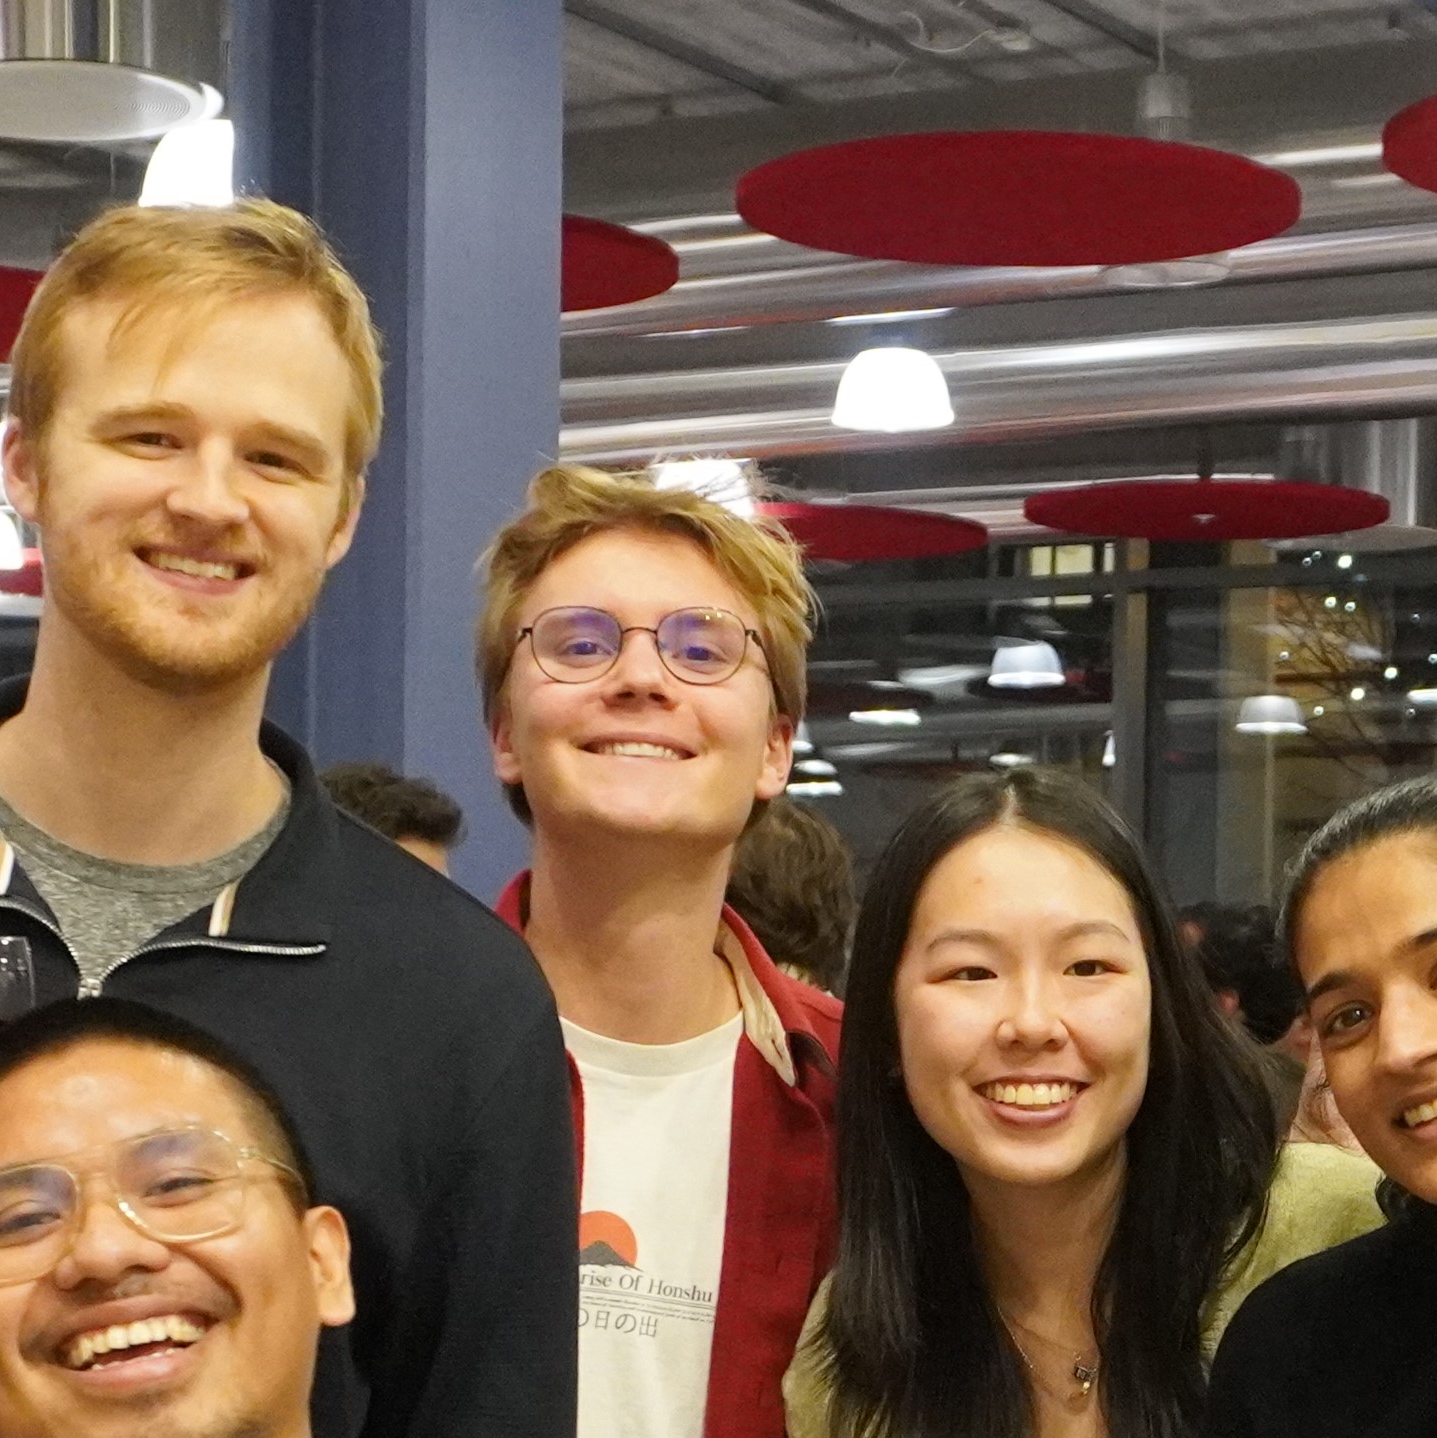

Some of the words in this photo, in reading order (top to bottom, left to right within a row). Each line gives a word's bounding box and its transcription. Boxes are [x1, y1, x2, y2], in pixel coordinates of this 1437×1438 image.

[580, 1270, 611, 1287] rise
[618, 1273, 644, 1291] Of
[648, 1278, 712, 1302] Honshu
